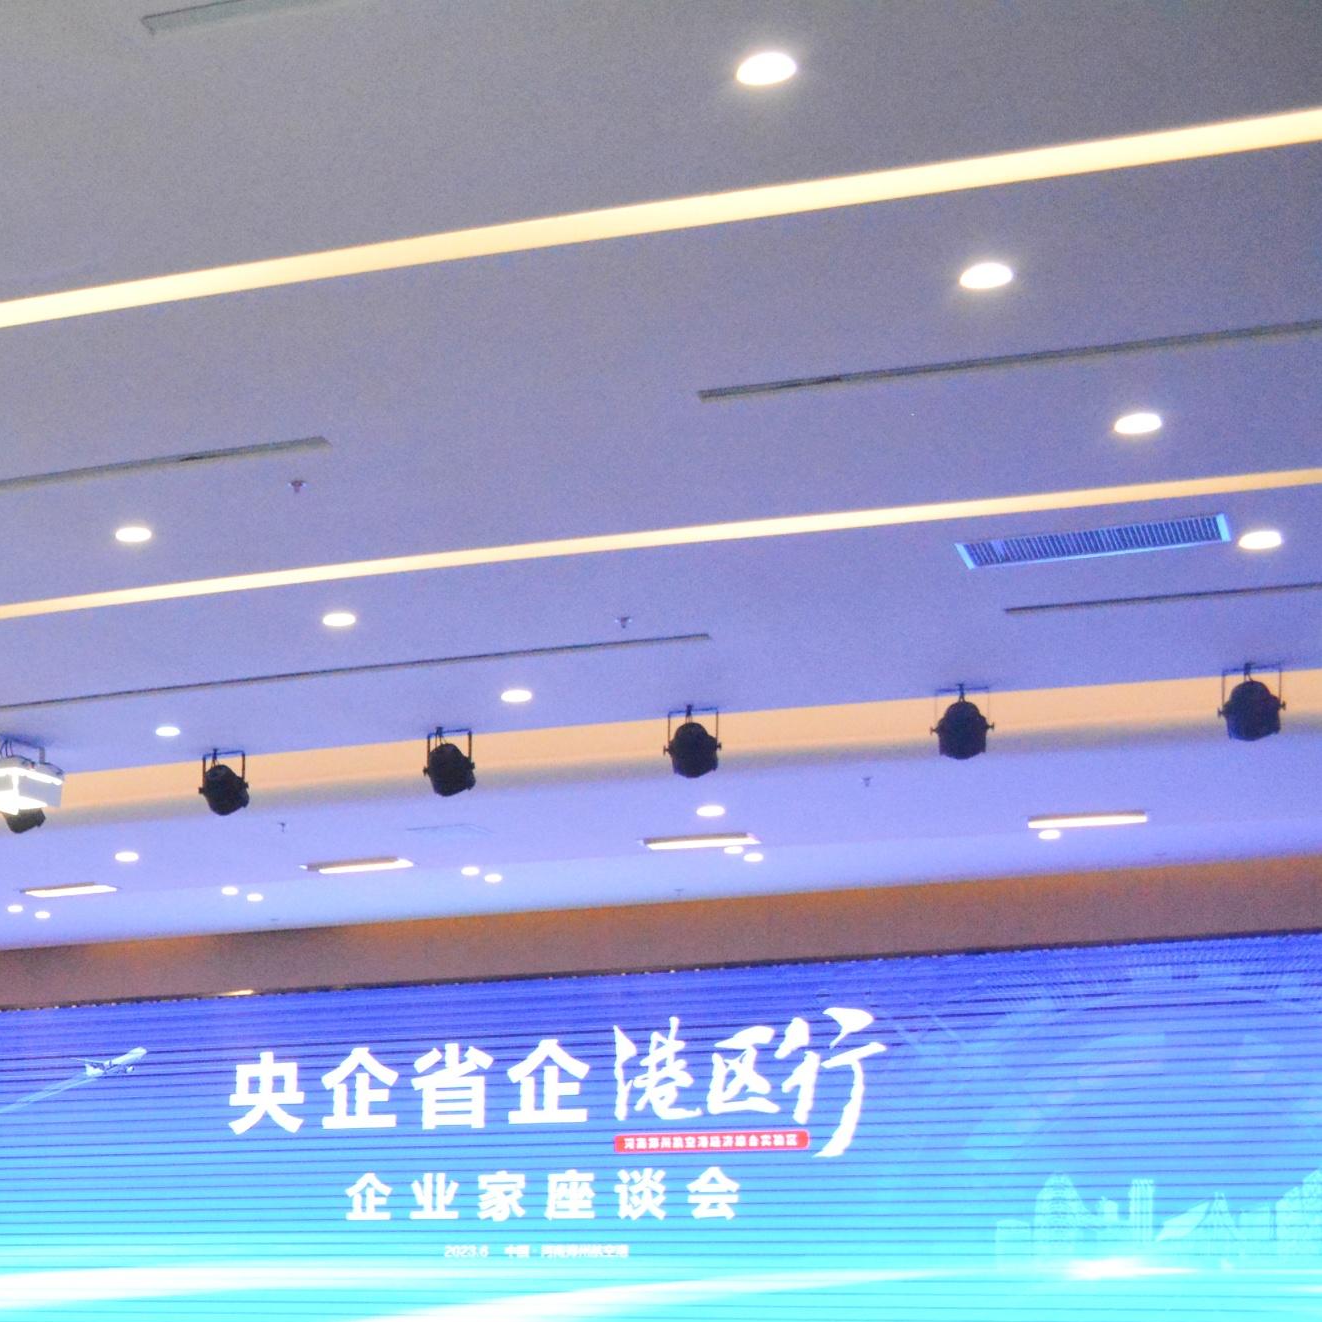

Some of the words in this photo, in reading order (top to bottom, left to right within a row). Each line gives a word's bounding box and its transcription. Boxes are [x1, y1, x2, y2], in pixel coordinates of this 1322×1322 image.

[228, 1006, 887, 1158] 央企省企港区行
[344, 1166, 741, 1222] 企业家座谈会
